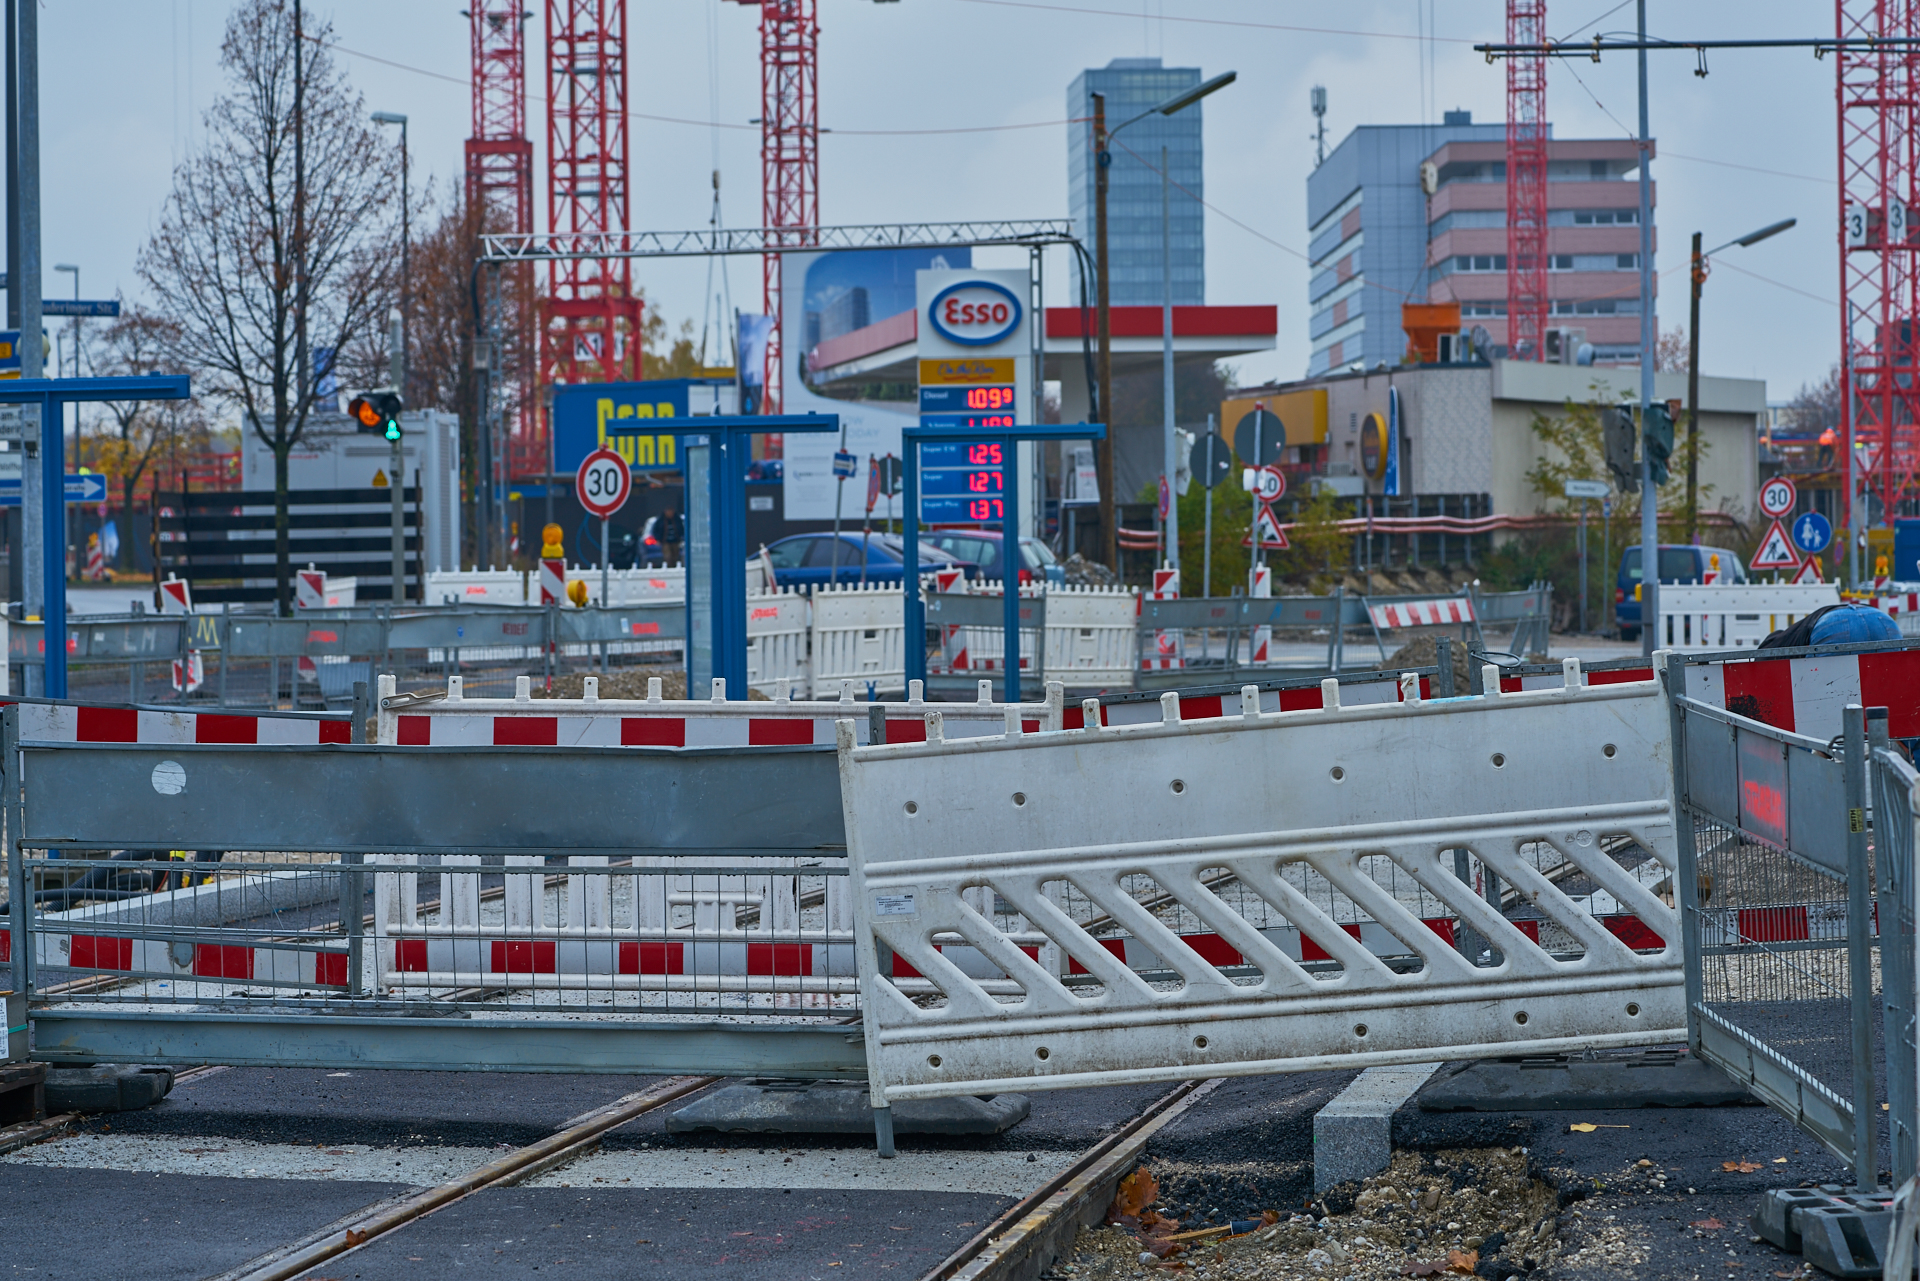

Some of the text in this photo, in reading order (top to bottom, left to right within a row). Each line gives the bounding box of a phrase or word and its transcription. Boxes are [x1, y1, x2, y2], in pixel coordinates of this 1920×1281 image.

[1851, 214, 1862, 238] 3
[1891, 204, 1903, 229] 3
[945, 298, 1009, 325] Esso
[588, 468, 618, 497] 30
[1767, 488, 1788, 507] 30
